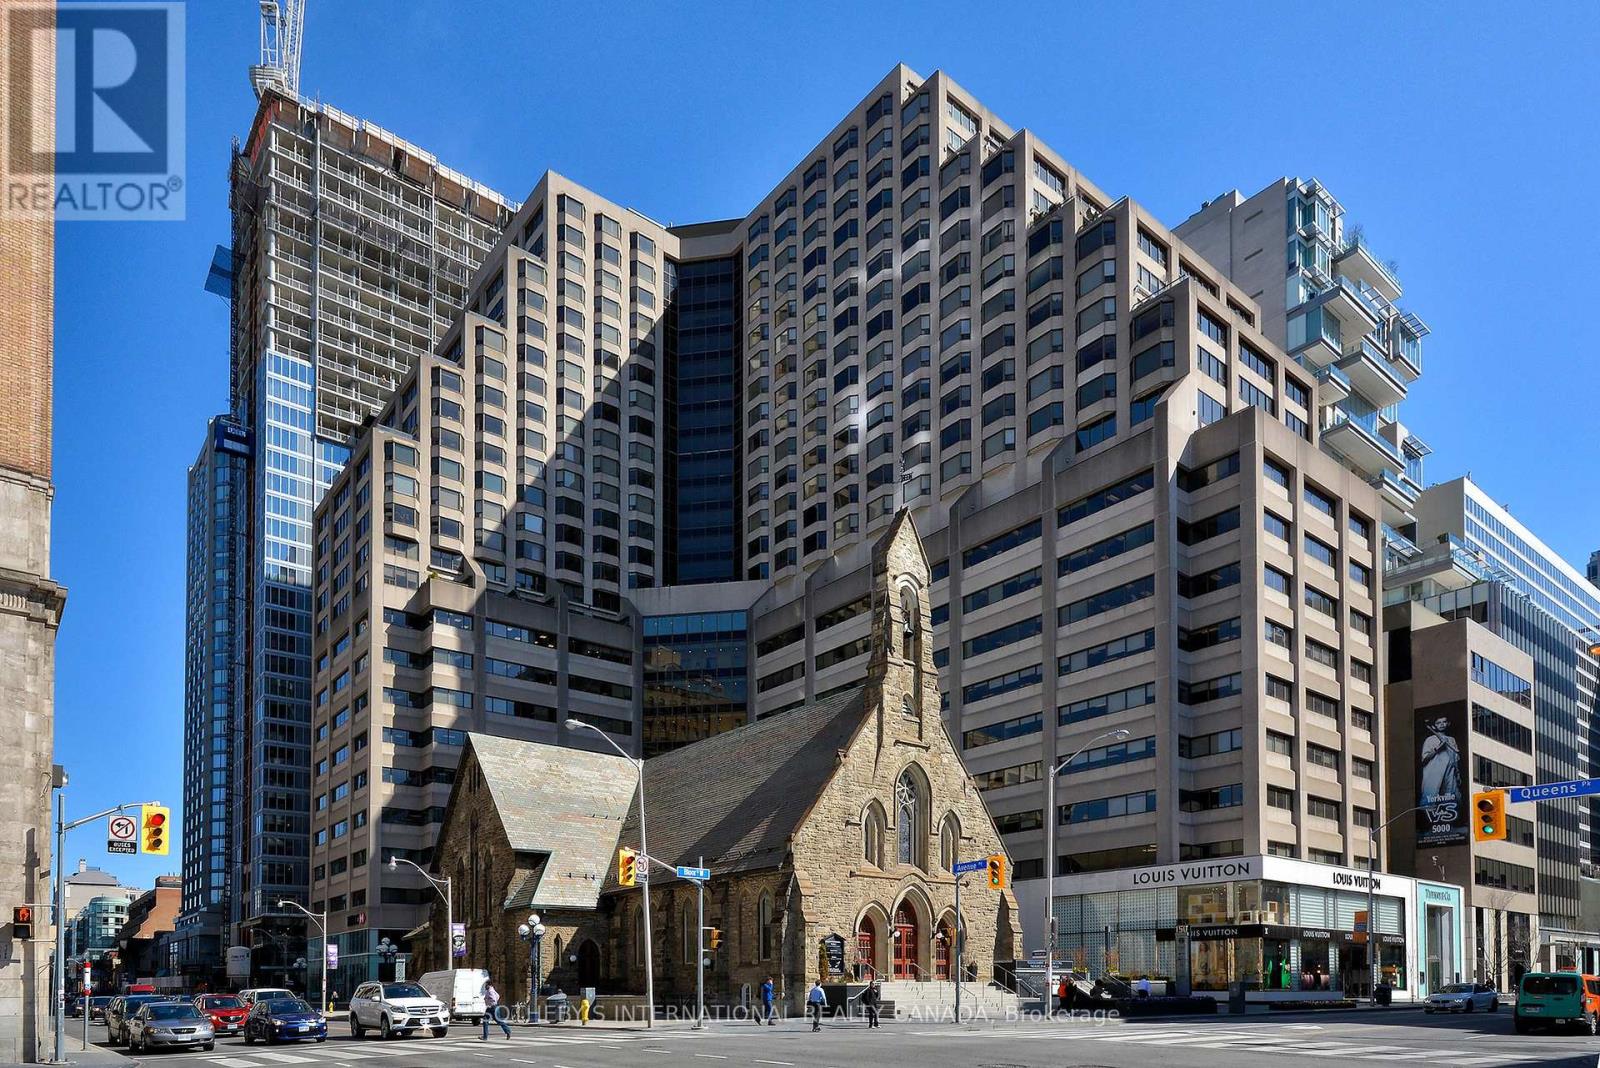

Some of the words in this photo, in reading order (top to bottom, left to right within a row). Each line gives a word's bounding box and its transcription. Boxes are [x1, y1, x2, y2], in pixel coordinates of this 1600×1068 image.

[1521, 784, 1577, 799] Queens
[1426, 802, 1458, 823] VS
[1432, 824, 1451, 833] 5000
[1133, 869, 1176, 885] LOUIS
[1180, 862, 1250, 880] VUITTON
[1333, 871, 1353, 886] LOUIS
[1354, 875, 1381, 890] VUITON
[1203, 928, 1238, 937] VUITTON
